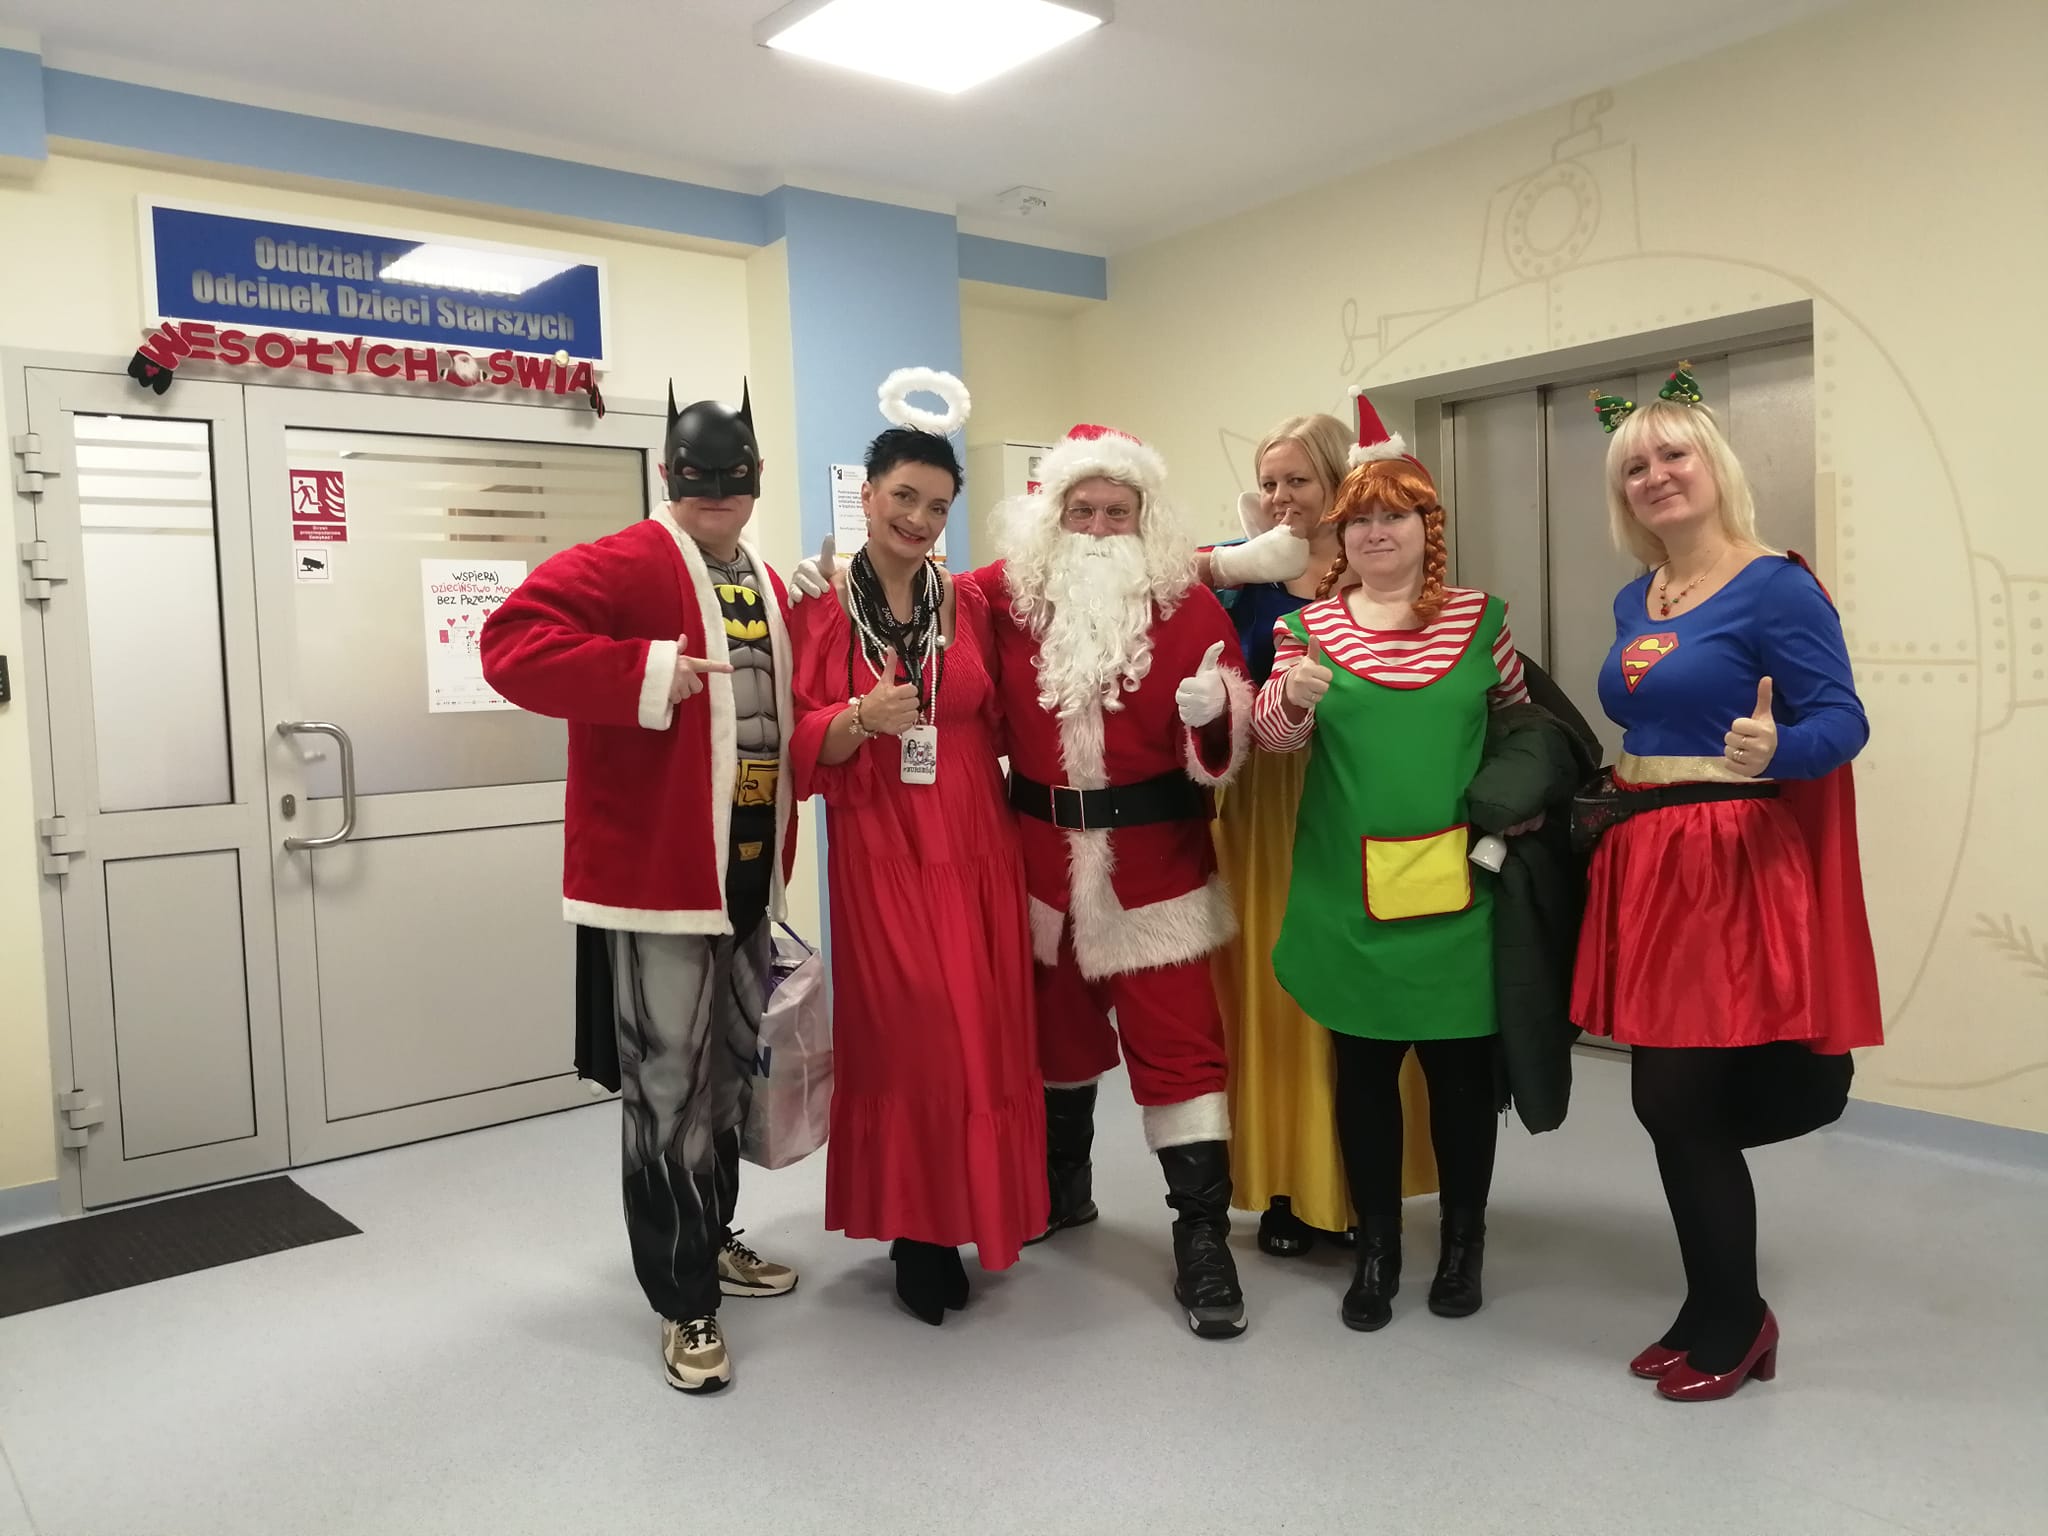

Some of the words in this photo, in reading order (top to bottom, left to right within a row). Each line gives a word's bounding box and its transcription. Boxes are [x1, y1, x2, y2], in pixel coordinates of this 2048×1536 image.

[255, 236, 375, 282] Oddział
[191, 269, 332, 315] Odcinek
[337, 284, 431, 327] Dzieci
[436, 296, 575, 341] Starszych
